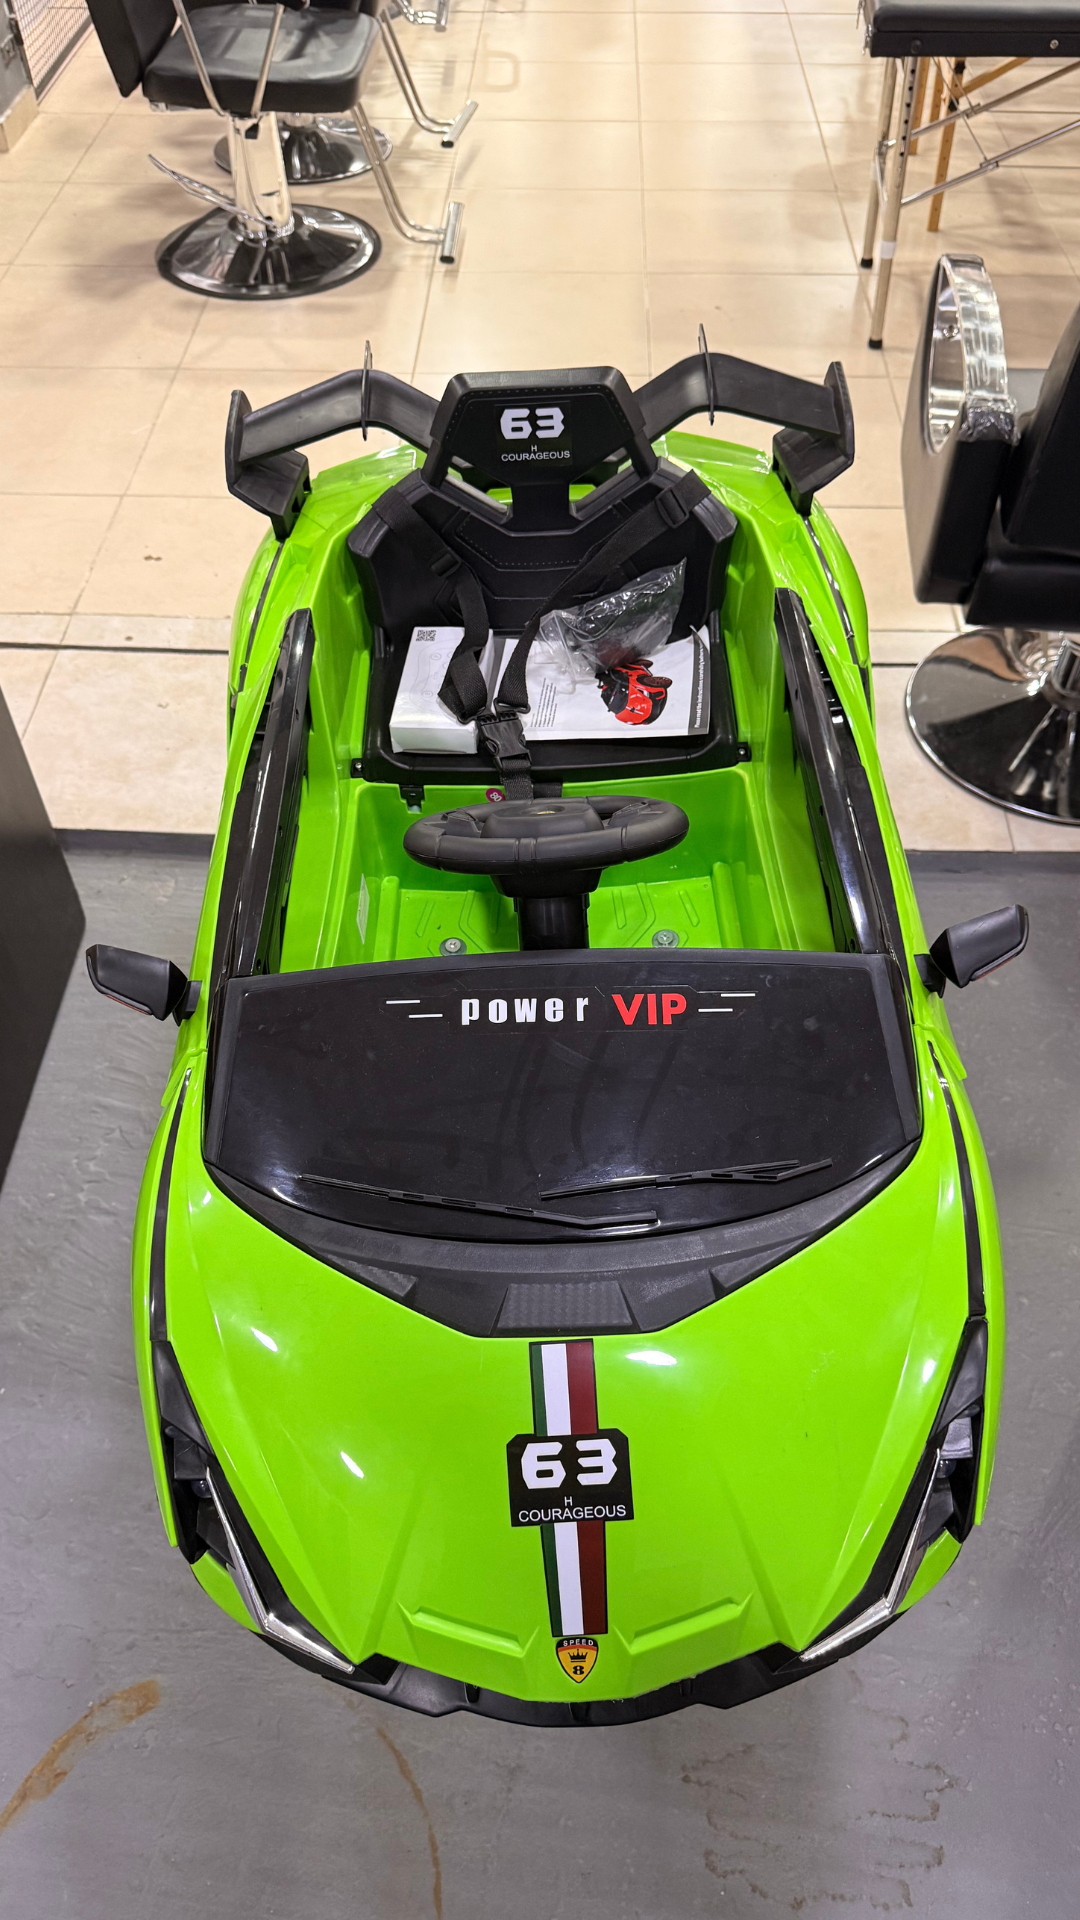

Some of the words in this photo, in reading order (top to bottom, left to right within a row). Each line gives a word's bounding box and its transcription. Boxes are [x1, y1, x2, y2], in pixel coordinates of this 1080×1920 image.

[500, 407, 565, 440] 63
[501, 450, 571, 462] COURAGEOUS
[461, 996, 589, 1026] power
[612, 992, 687, 1026] VIP
[520, 1438, 618, 1490] 63
[564, 1496, 573, 1506] H
[518, 1504, 627, 1523] COURAGEOUS
[562, 1638, 594, 1647] SPEED
[572, 1665, 585, 1676] 8
